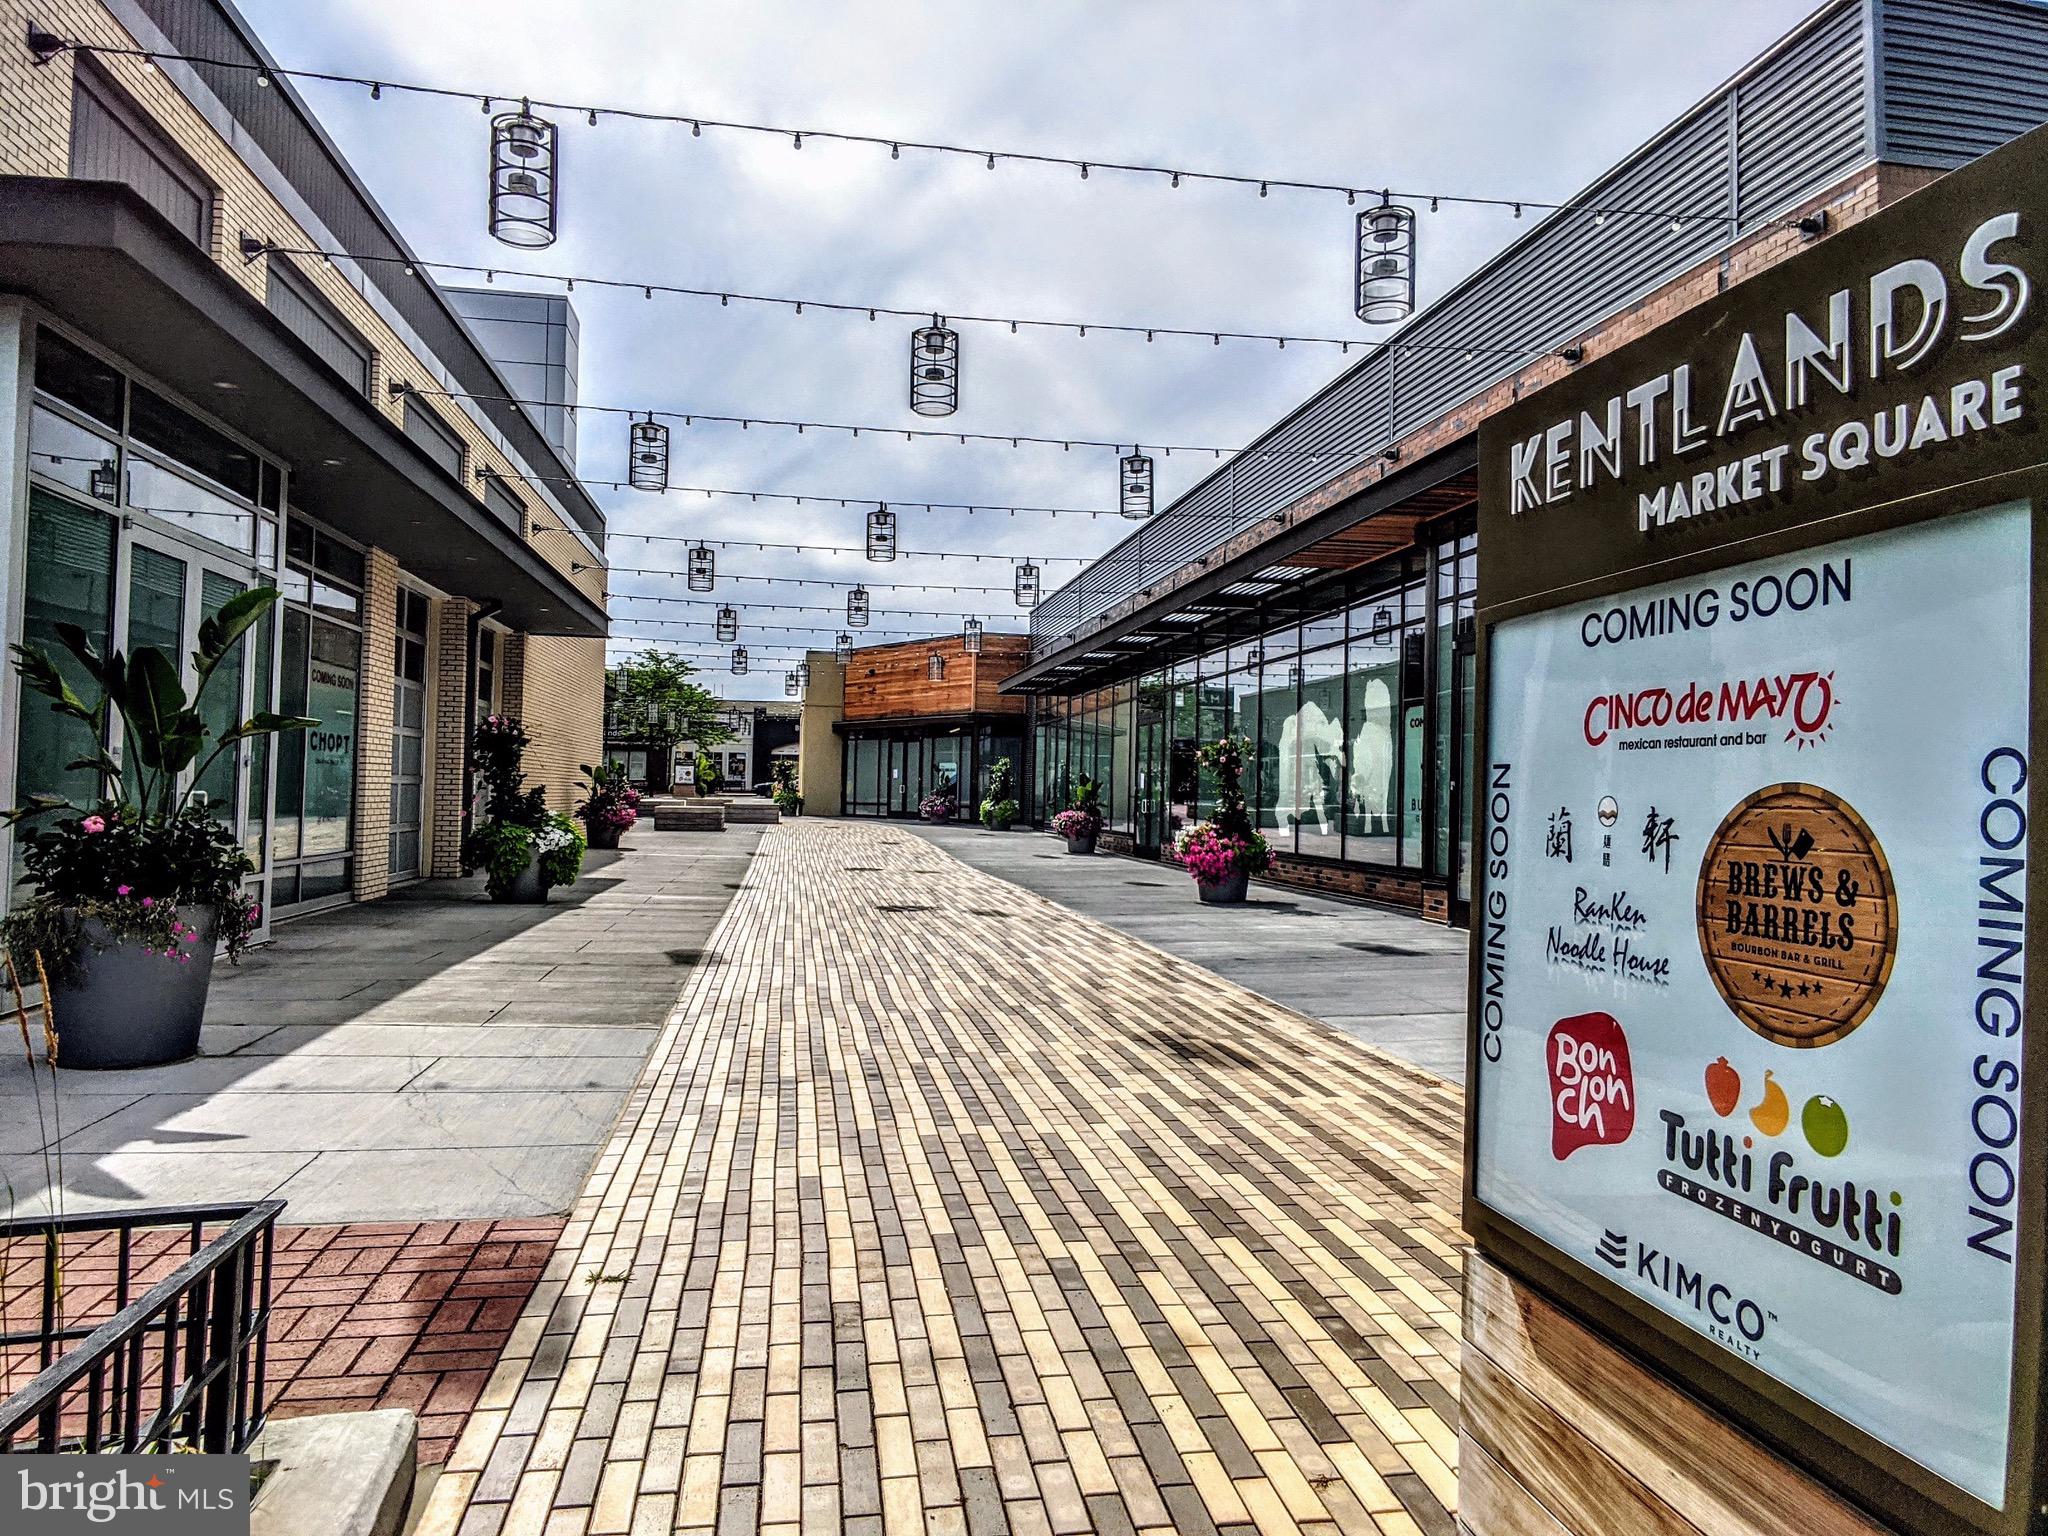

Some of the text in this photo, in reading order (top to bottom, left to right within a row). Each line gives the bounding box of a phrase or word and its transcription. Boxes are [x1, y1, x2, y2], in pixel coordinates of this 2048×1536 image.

[1510, 211, 2032, 516] KENTLANDS
[1639, 364, 2024, 532] MARKET SQUARE
[1581, 558, 1852, 648] COMING SOON
[311, 668, 355, 690] COMING SOON
[1584, 671, 1831, 747] CINCO de MAYO
[310, 730, 351, 753] CHOPT
[1618, 731, 1767, 751] mexican restaurant and bar
[1574, 886, 1647, 923] RanKen
[1726, 860, 1859, 907] BREWS &
[1483, 763, 1511, 1063] COMING SOON
[1725, 899, 1855, 952] BARRELS
[1546, 925, 1670, 976] Noodle House
[1730, 942, 1845, 970] BOURBON BAR & GRILL
[1966, 745, 2028, 1265] COMING SOON
[1659, 1109, 1753, 1193] Tutti
[1637, 1242, 1765, 1342] KIMCO
[1709, 1324, 1761, 1361] REALTY
